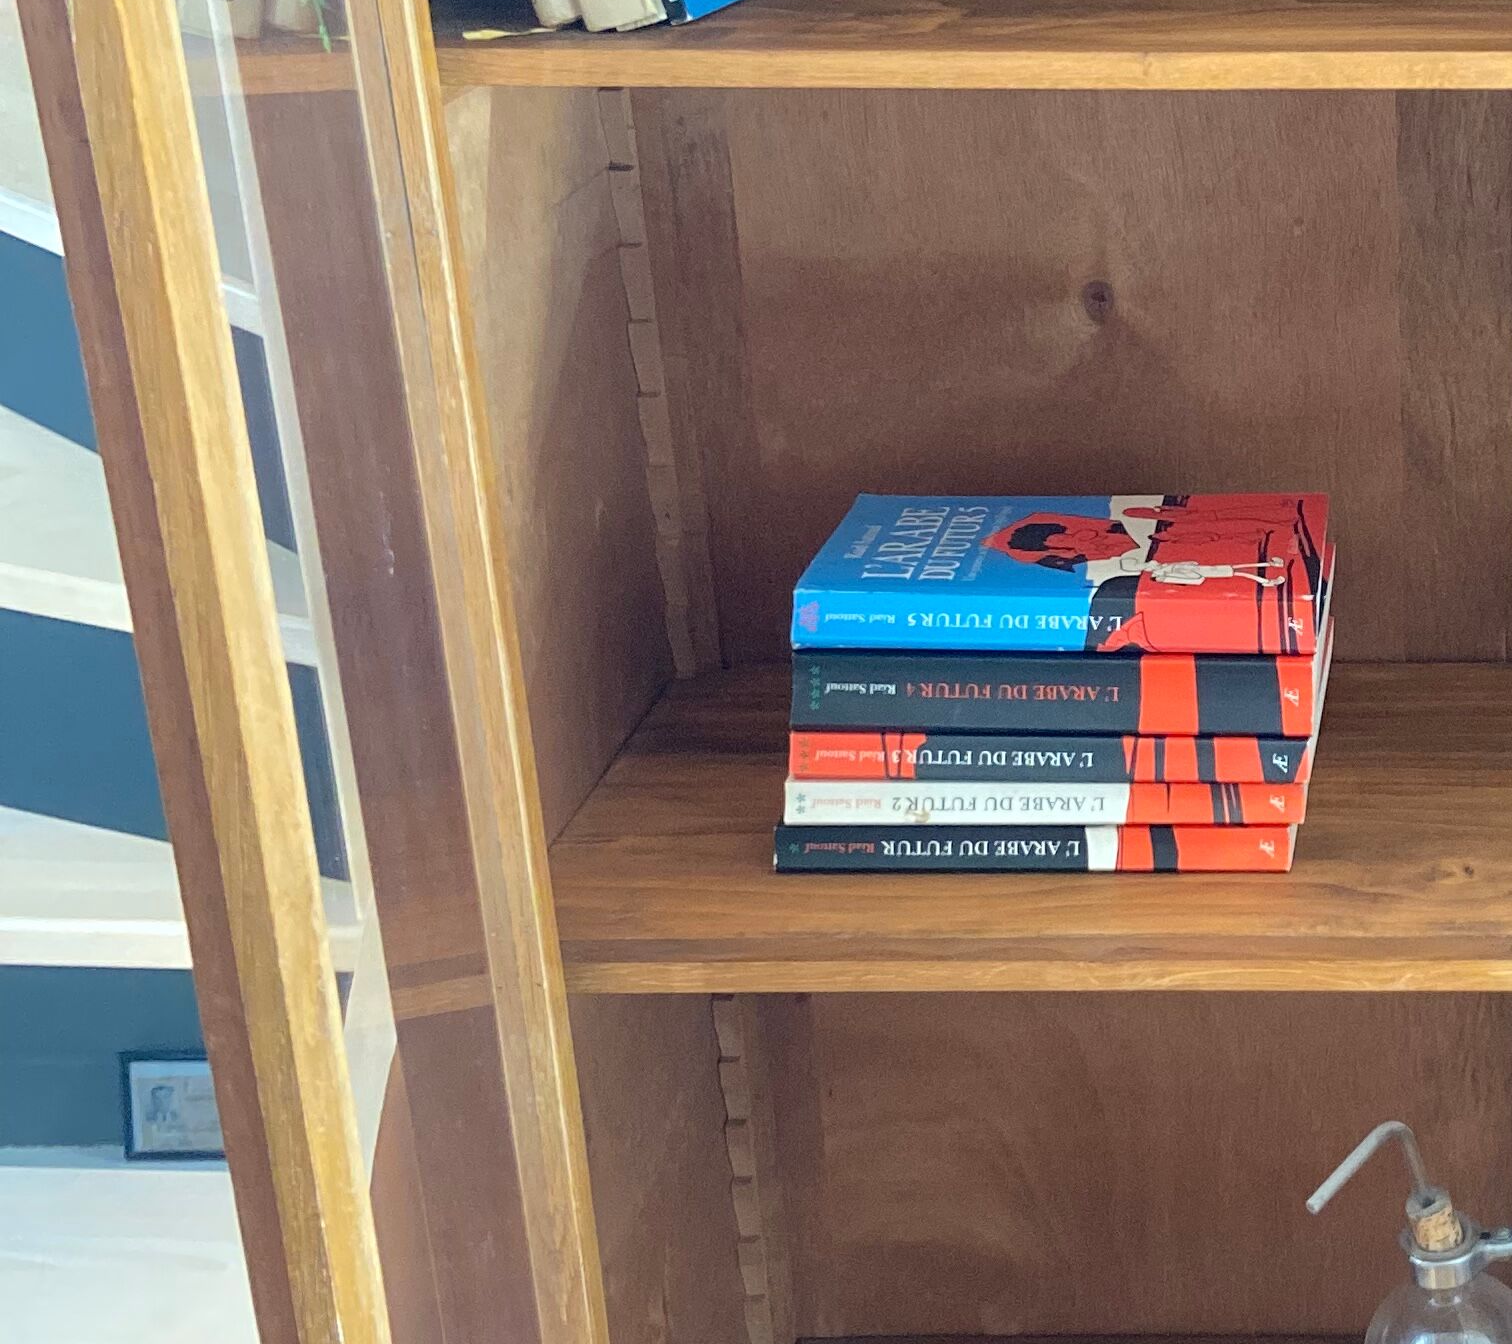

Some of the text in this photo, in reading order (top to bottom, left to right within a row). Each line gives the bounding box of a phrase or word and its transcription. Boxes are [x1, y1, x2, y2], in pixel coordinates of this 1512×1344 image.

[860, 505, 951, 581] L'ARABE
[931, 513, 986, 559] FUTUR
[917, 558, 961, 581] DU
[907, 612, 917, 627] 5
[919, 612, 993, 629] FUTUR
[999, 613, 1030, 629] DU
[824, 682, 897, 696] Riad Sattouf
[906, 682, 914, 698] 4
[920, 682, 991, 699] FUTUR
[997, 683, 1028, 701] DU
[891, 749, 900, 764] 3
[906, 749, 973, 765] FUTUR
[977, 750, 1007, 766] DU
[892, 796, 902, 811] 2
[906, 796, 978, 813] FUTUR
[983, 796, 1014, 812] DU
[880, 839, 953, 857] FUTUR
[959, 840, 990, 857] DU
